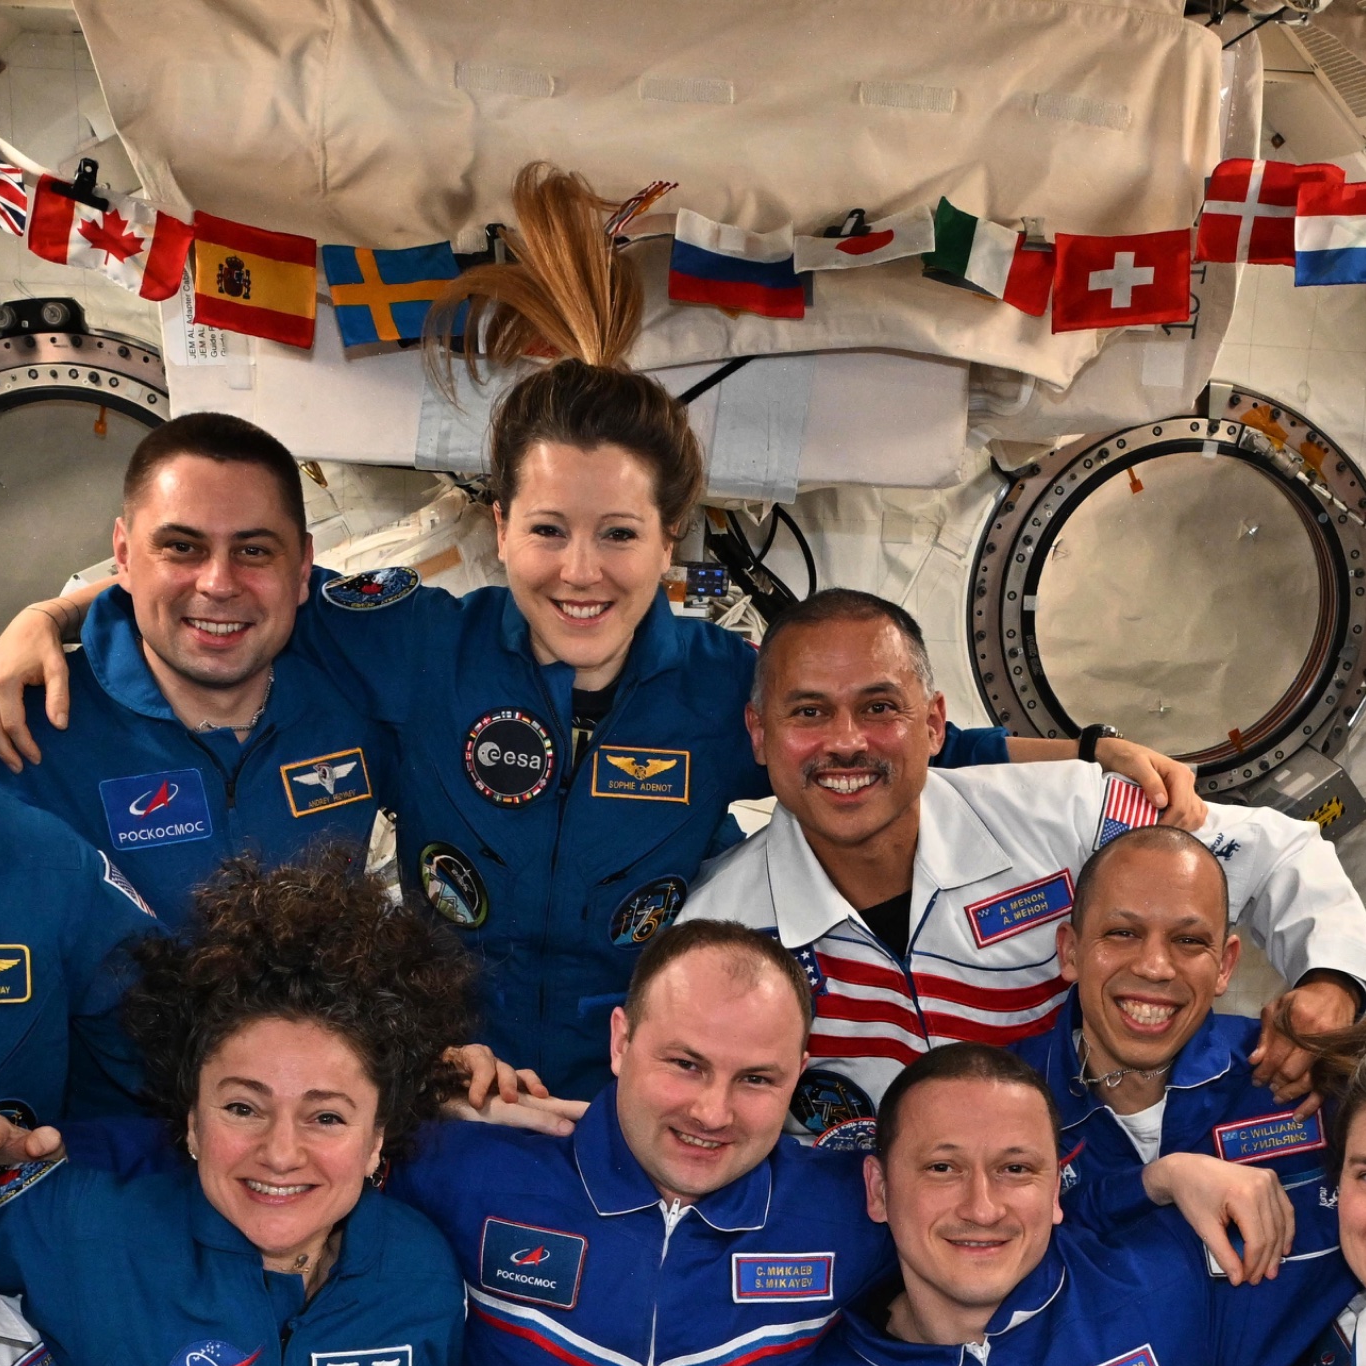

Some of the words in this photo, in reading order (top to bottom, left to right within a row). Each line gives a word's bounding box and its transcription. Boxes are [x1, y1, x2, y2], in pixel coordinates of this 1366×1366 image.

[185, 294, 194, 324] Adapter
[188, 328, 195, 339] AL
[198, 327, 205, 338] AL
[199, 340, 207, 358] JEM
[210, 333, 218, 357] Guide
[502, 750, 542, 771] esa
[608, 779, 636, 791] SOPHIE
[640, 781, 673, 793] ADENOT
[308, 795, 331, 809] ANDREY
[118, 820, 206, 844] РОСКОСМОС
[1010, 891, 1046, 912] MENON
[1013, 900, 1049, 923] МЕНОН
[1250, 1120, 1304, 1141] WILLIAMS
[1251, 1132, 1308, 1151] УИЛЬЯМС
[496, 1268, 557, 1290] РОСКОСМОС
[767, 1265, 813, 1278] МИКАЕВ
[754, 1278, 766, 1290] S.
[765, 1277, 814, 1289] MIKAYEV
